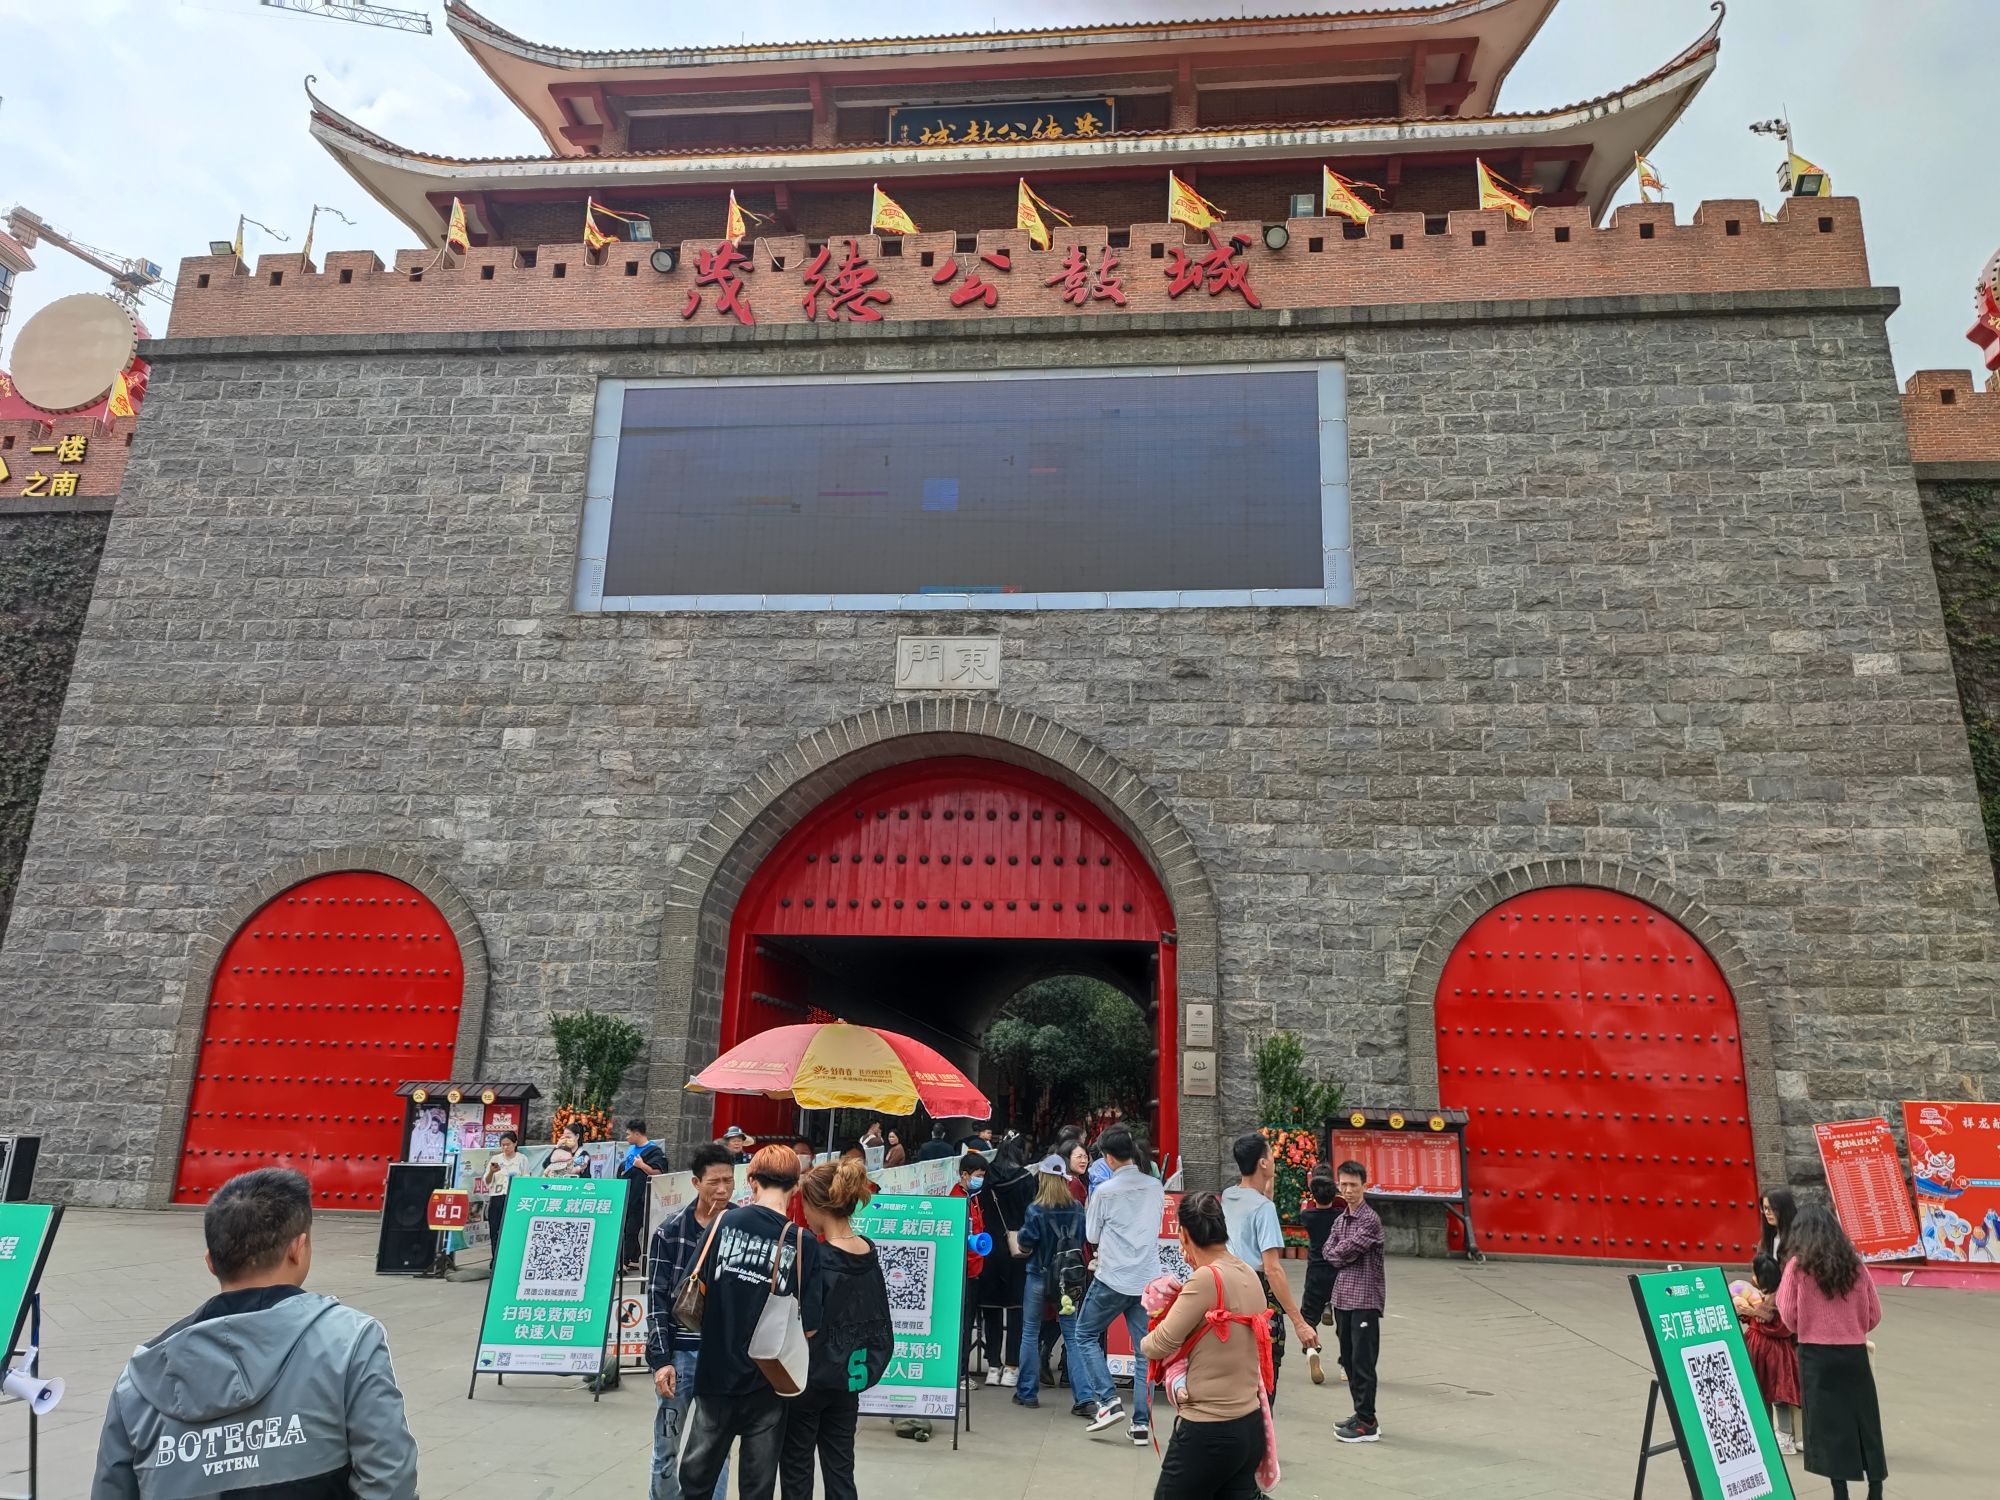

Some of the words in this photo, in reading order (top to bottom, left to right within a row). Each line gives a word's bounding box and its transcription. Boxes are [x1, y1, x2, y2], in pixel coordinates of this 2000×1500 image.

[30, 435, 88, 463] 一楼
[21, 470, 80, 496] 之南
[435, 1204, 462, 1219] 出口
[516, 1197, 564, 1213] 买门票
[851, 1217, 898, 1235] 买门票
[502, 1305, 593, 1323] 扫码免费预约
[1659, 1310, 1696, 1341] 买门票
[514, 1324, 575, 1341] 快速入园
[848, 1348, 868, 1392] S
[155, 1414, 307, 1467] BOTEGEA
[202, 1454, 260, 1477] VETENA
